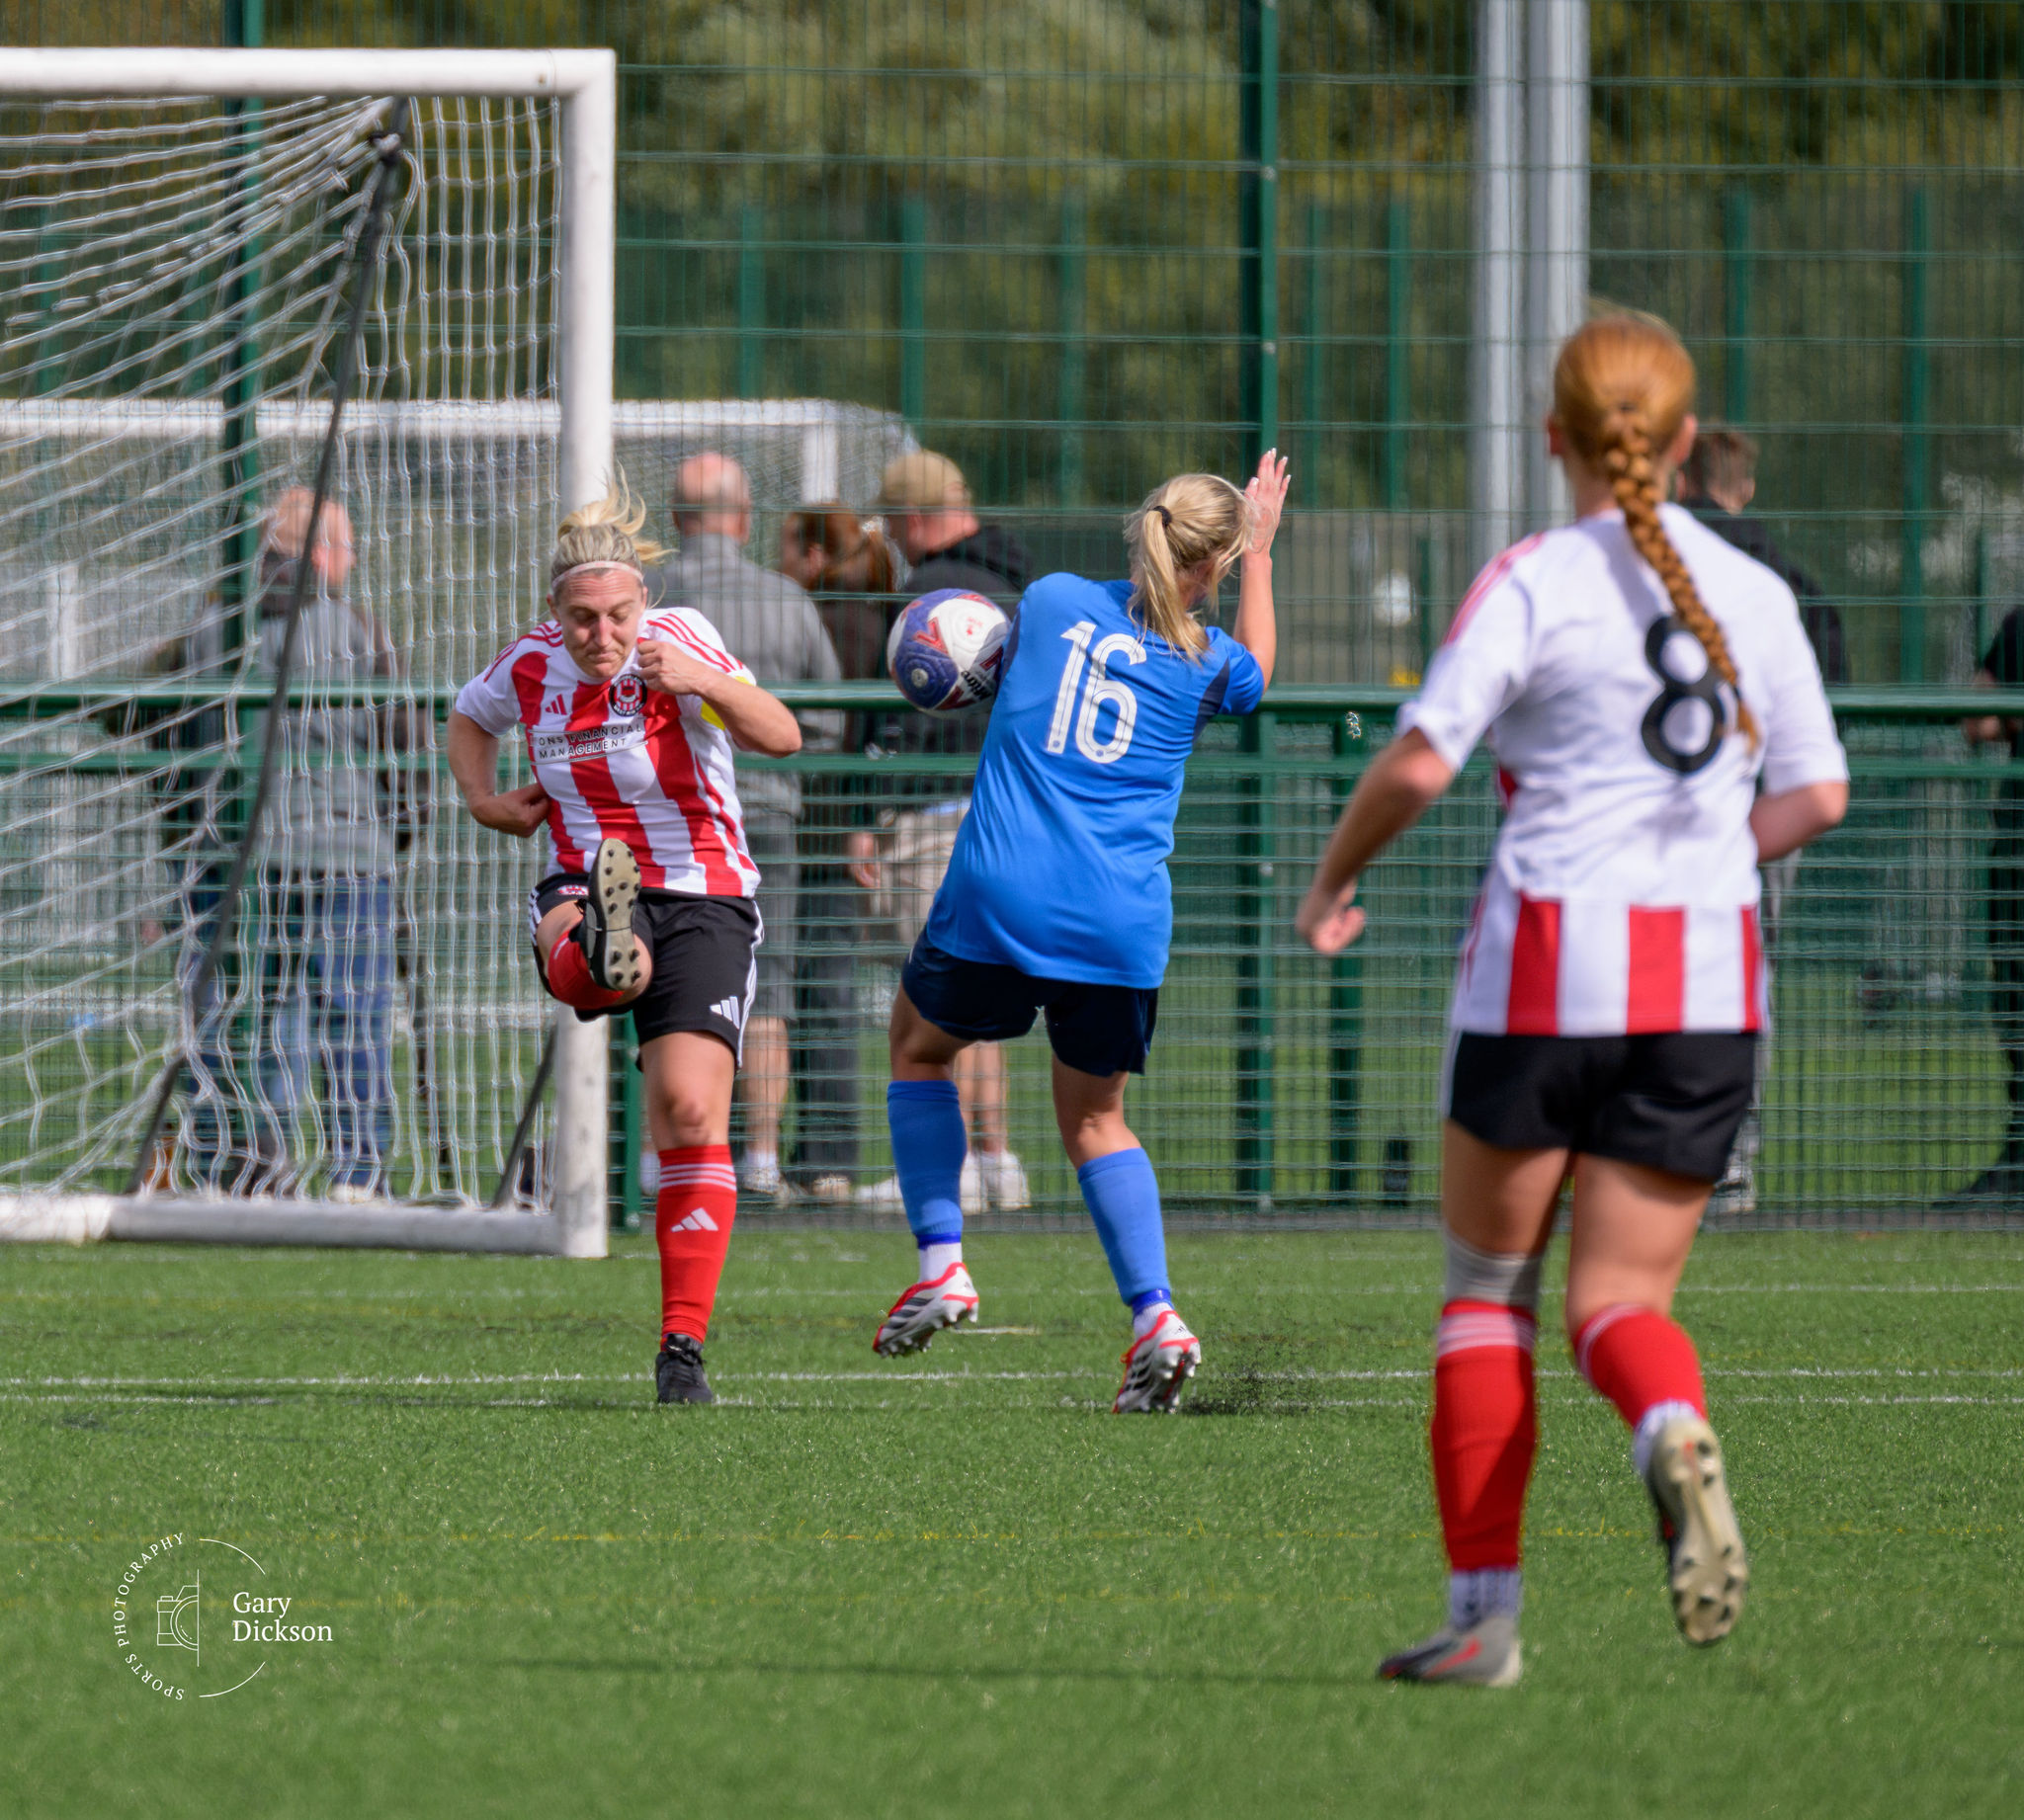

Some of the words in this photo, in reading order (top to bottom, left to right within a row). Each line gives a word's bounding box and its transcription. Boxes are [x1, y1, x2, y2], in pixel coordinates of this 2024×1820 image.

[569, 724, 641, 743] FINANCIAL
[1047, 620, 1146, 764] 16
[1641, 615, 1728, 776] 8
[539, 737, 627, 760] MANAGEMENT
